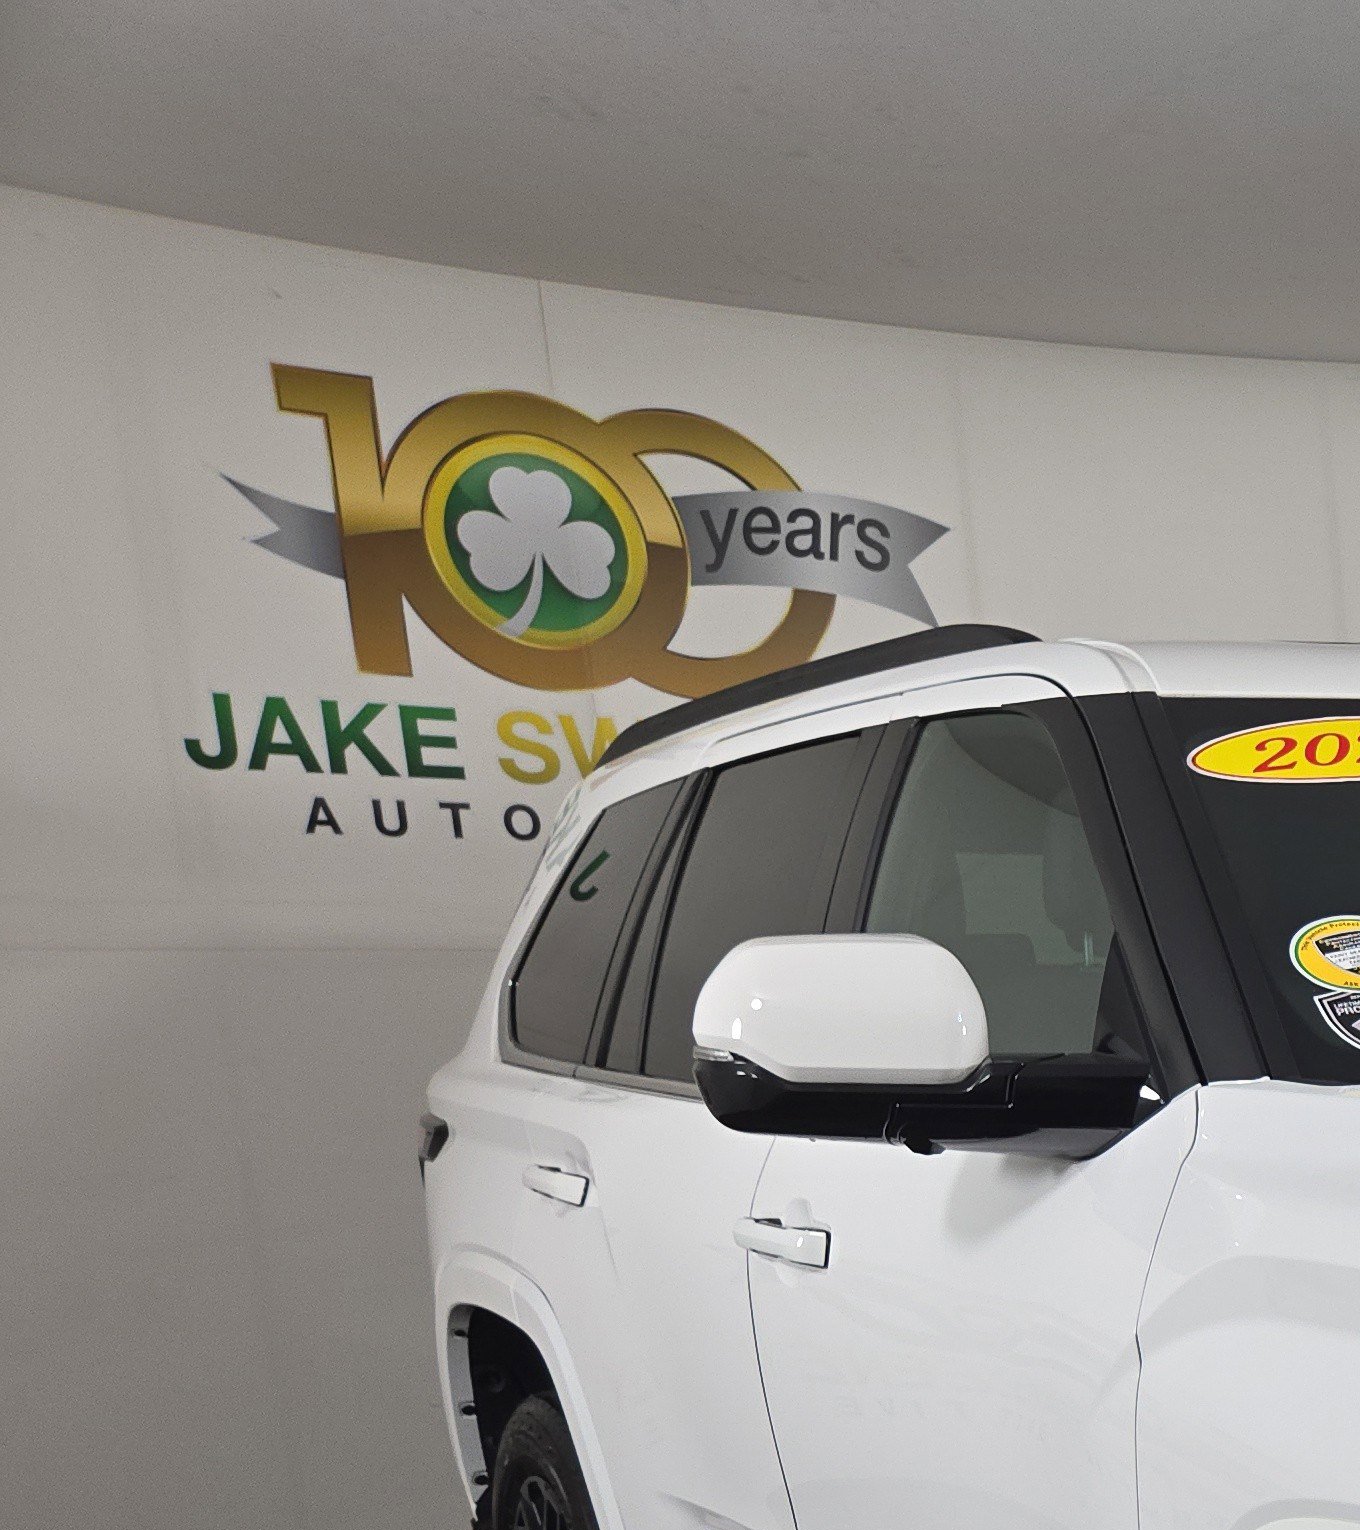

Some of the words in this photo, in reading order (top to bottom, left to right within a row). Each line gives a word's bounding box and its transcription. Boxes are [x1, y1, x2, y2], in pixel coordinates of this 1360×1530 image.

[269, 361, 838, 699] 100
[698, 503, 893, 573] years
[184, 692, 466, 780] JAKE
